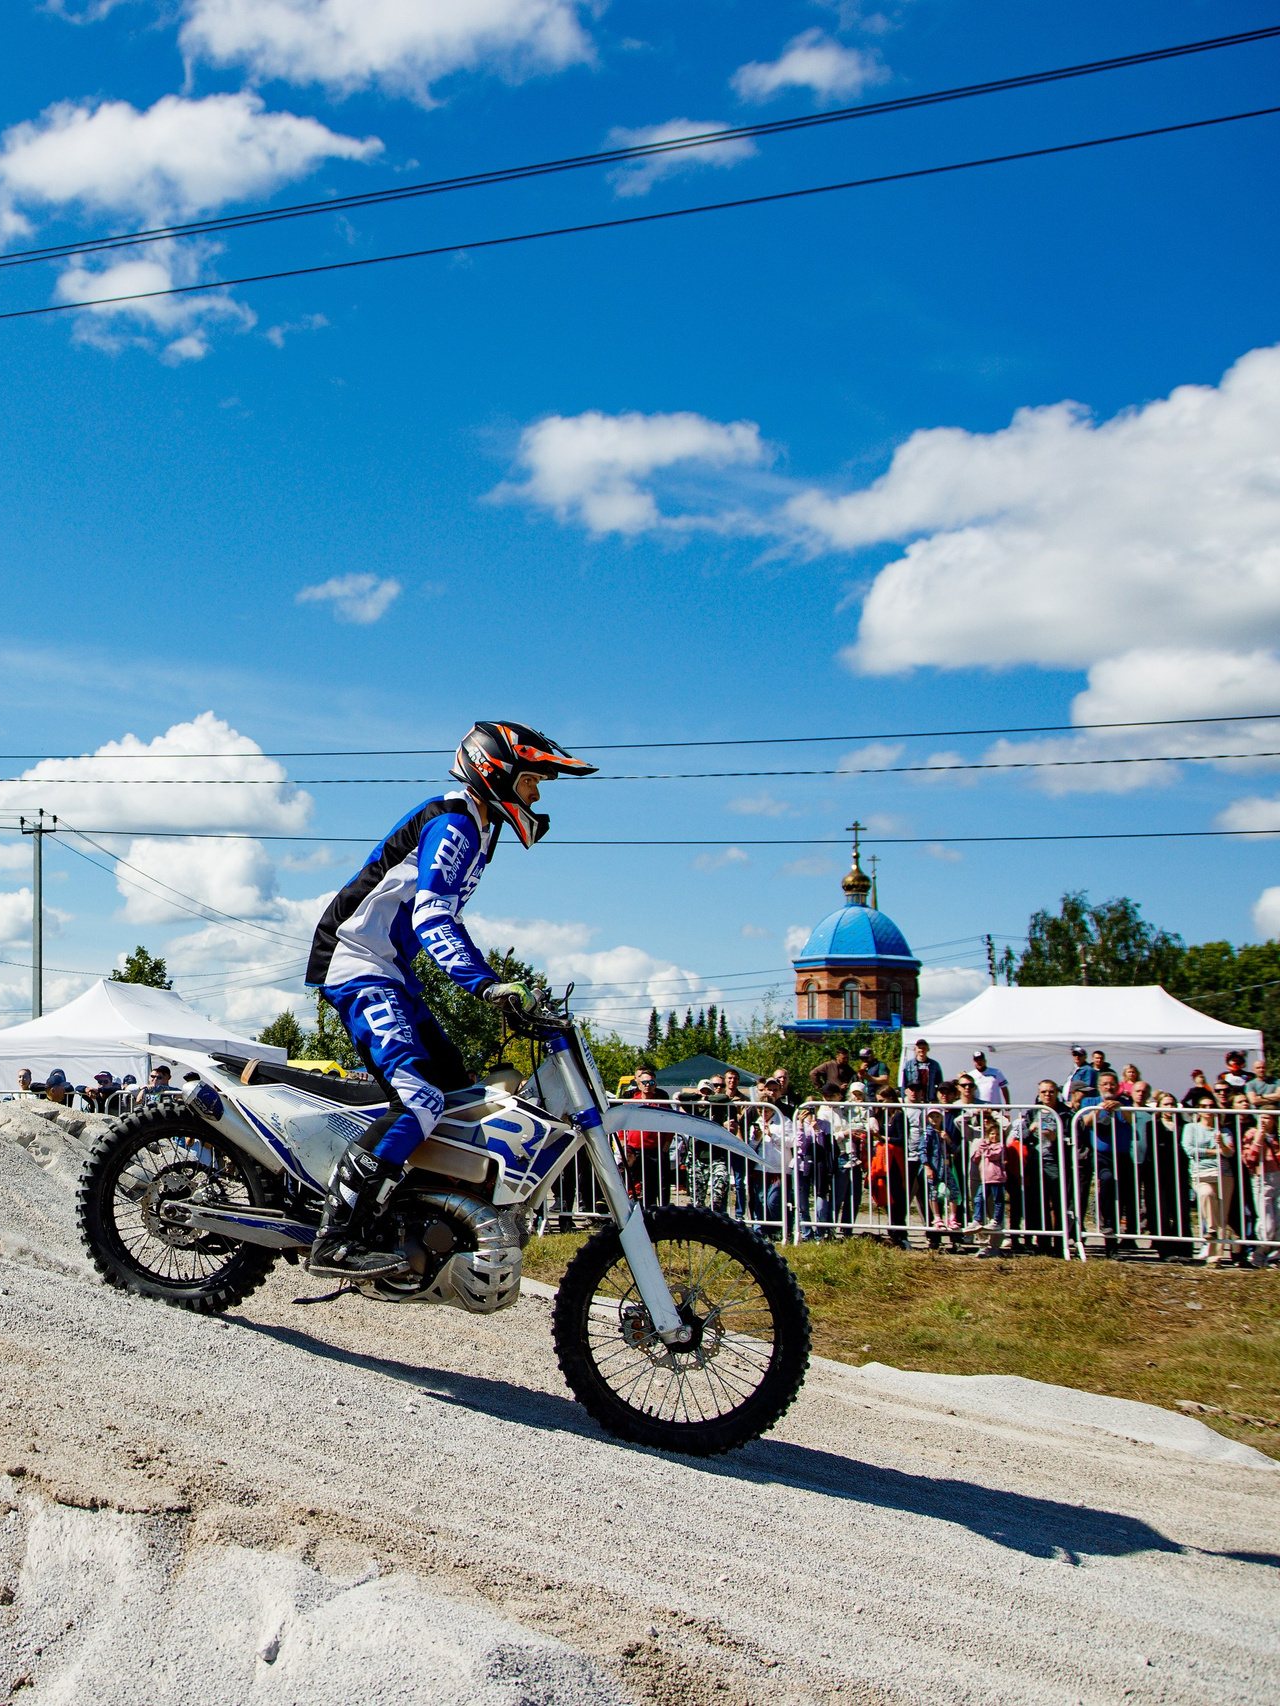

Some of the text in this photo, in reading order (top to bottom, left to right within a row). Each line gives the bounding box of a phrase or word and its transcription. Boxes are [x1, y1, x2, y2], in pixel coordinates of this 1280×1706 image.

[430, 824, 466, 882] FOX
[420, 926, 468, 974] FOX
[356, 986, 408, 1049] FOX
